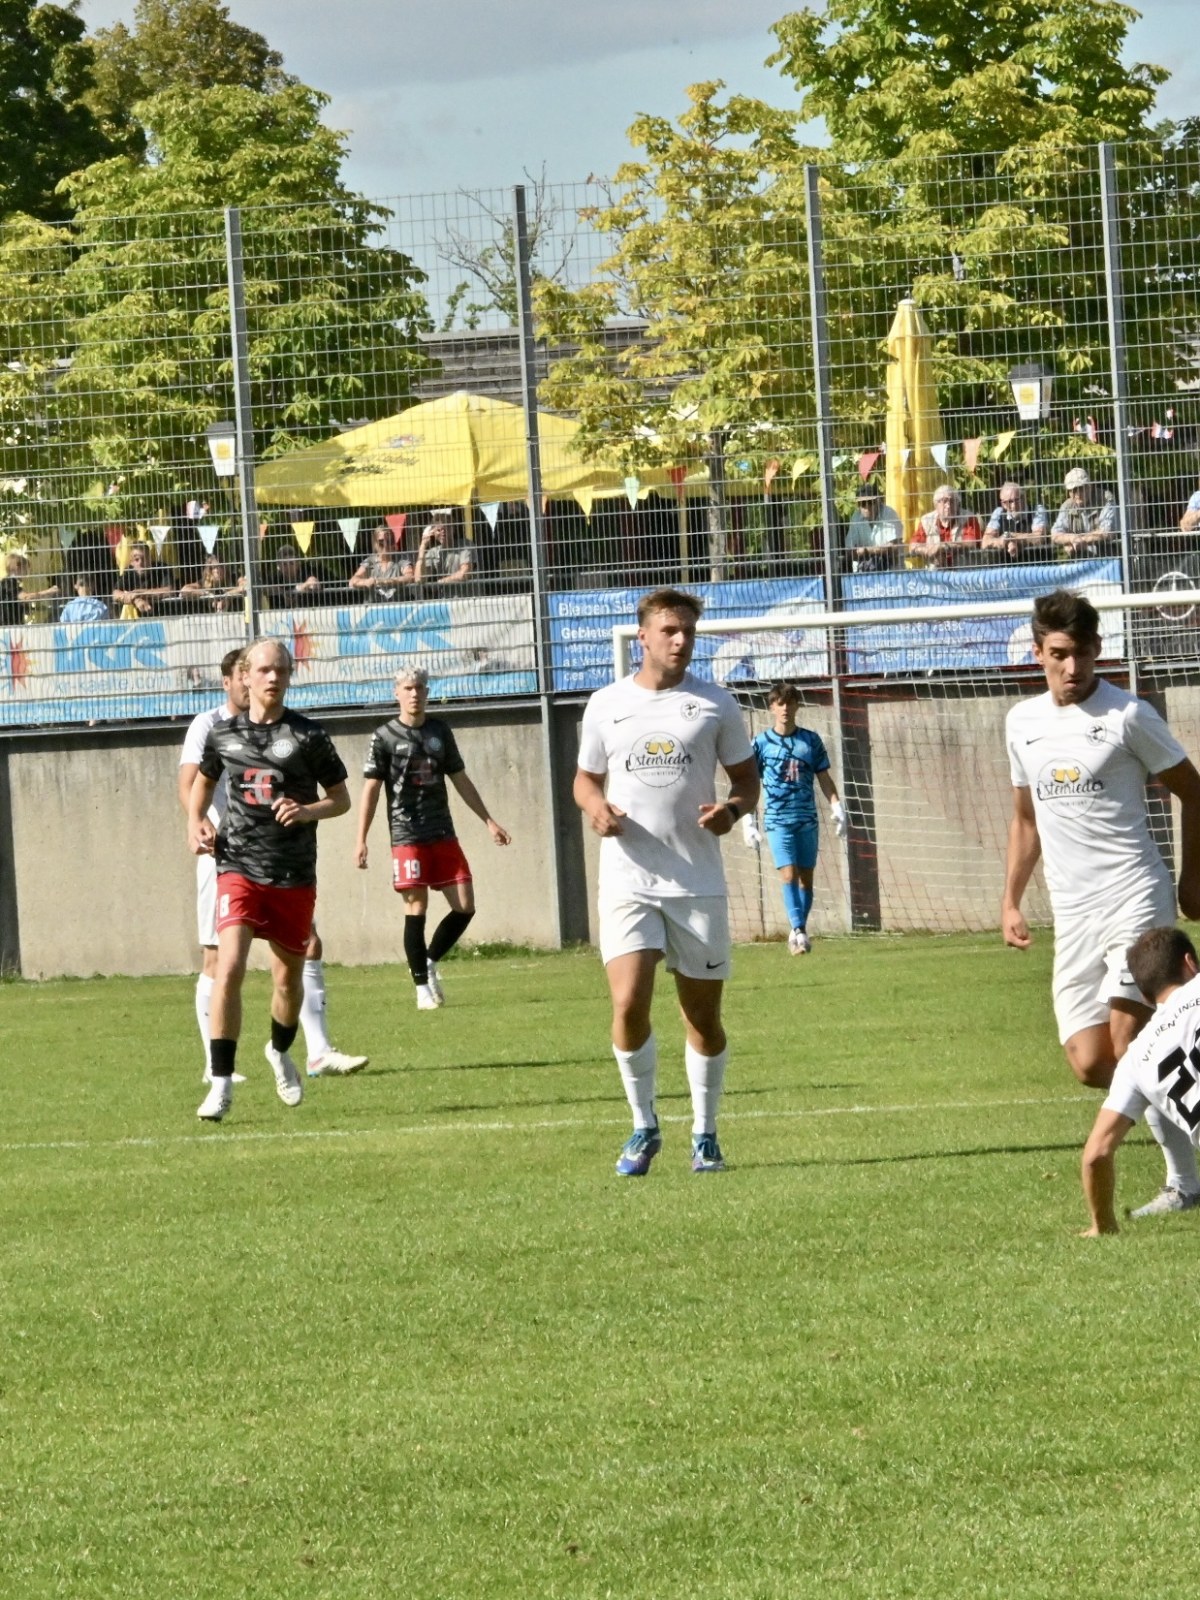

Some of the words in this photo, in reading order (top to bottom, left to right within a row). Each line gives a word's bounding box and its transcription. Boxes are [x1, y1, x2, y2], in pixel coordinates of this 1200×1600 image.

[852, 584, 903, 598] Bleiben
[907, 582, 930, 596] Sie
[558, 602, 611, 616] Bleiben
[613, 599, 635, 614] Sie
[403, 859, 421, 879] 19
